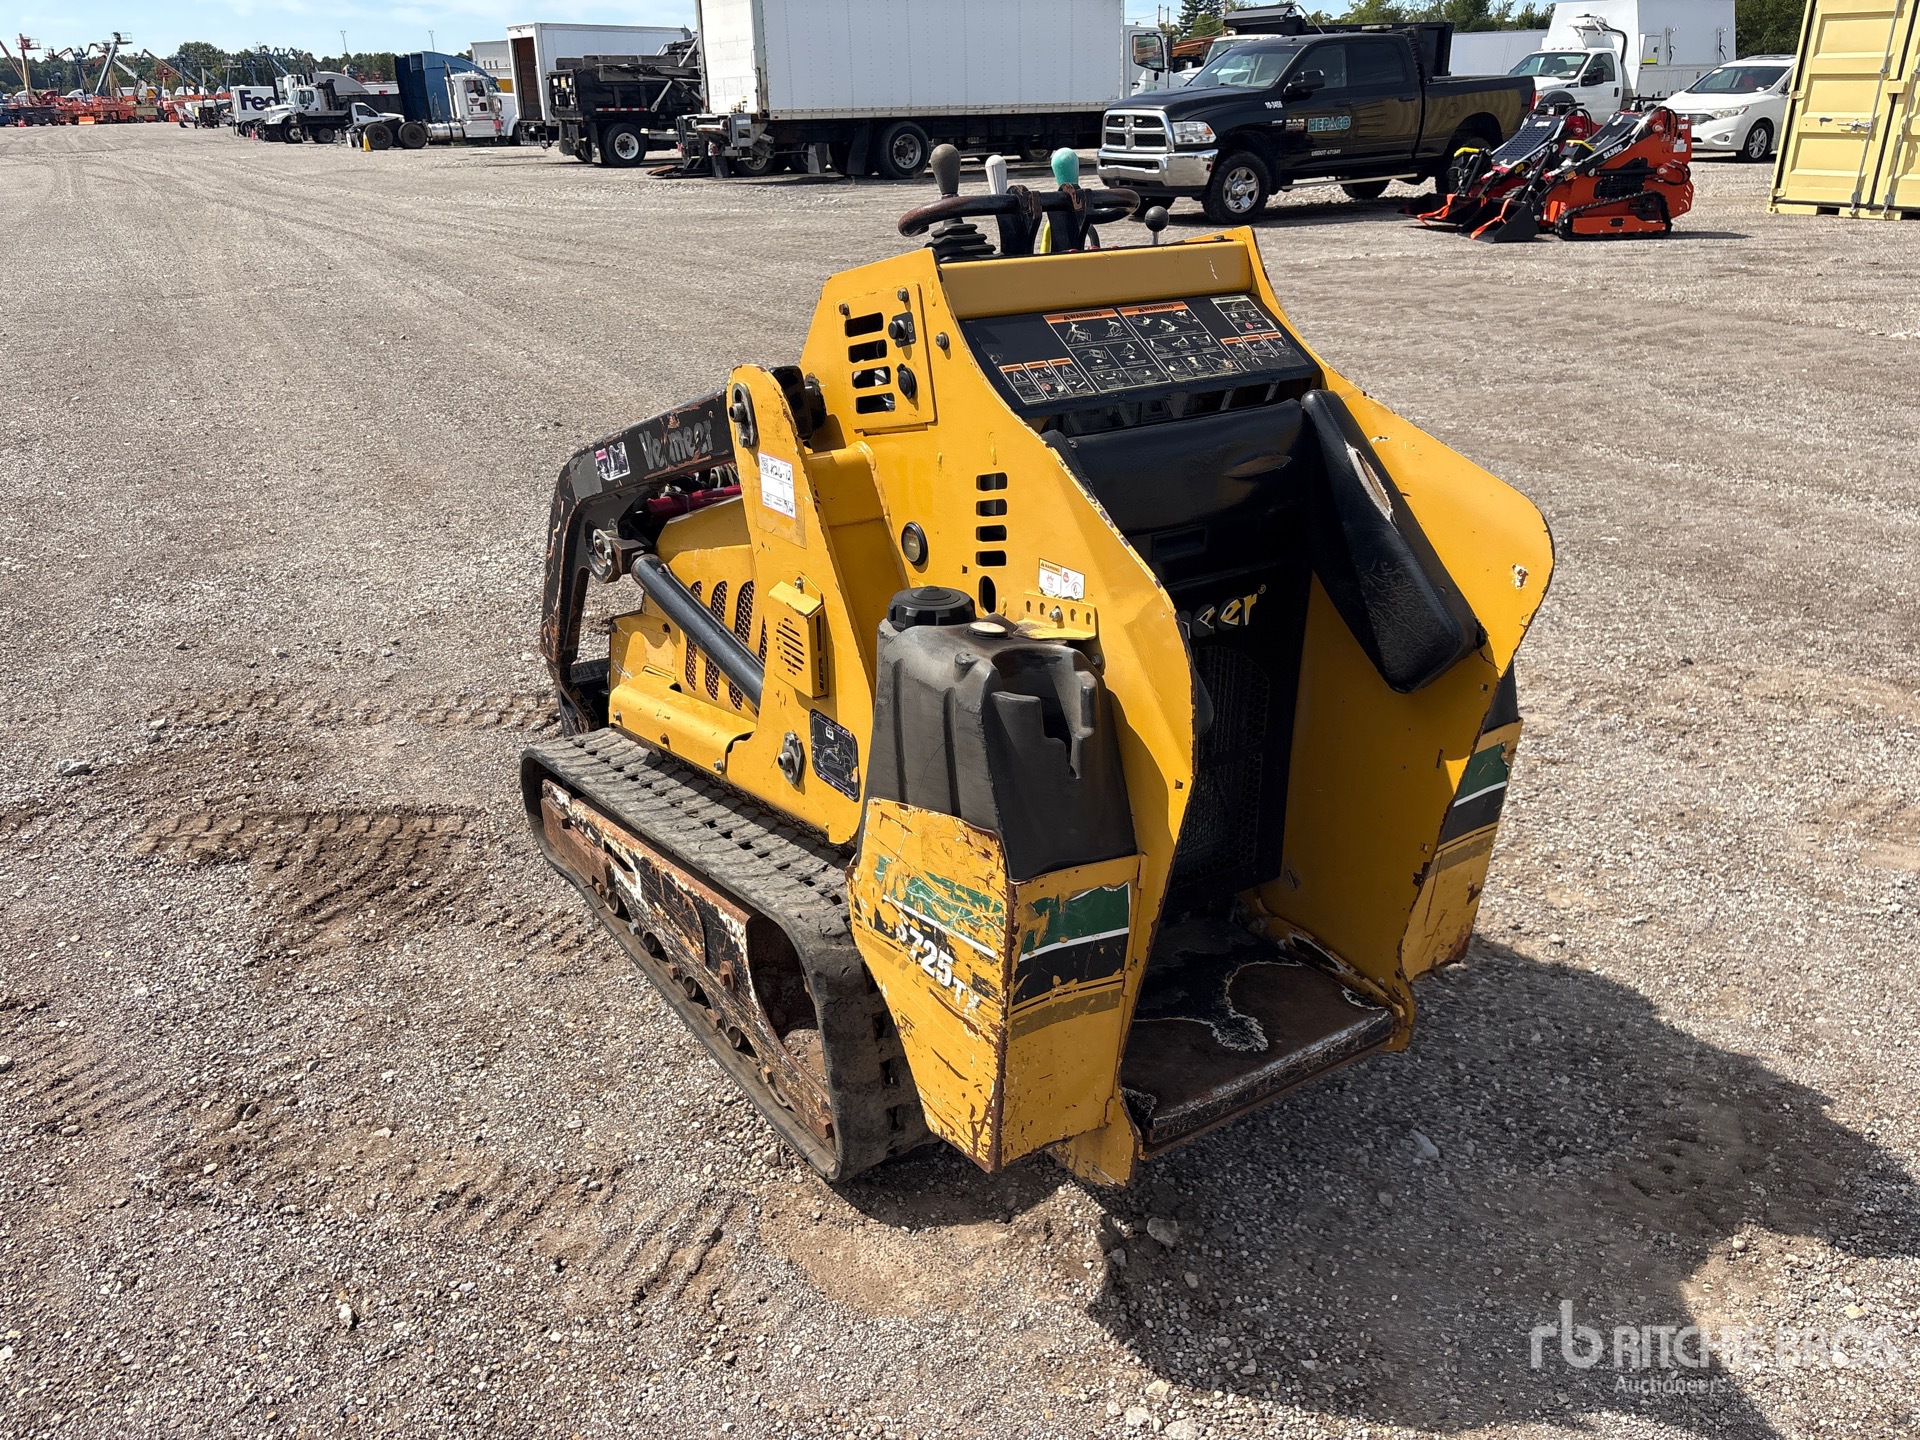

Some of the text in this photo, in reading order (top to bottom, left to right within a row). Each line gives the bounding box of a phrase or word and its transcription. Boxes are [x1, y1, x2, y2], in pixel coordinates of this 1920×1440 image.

[1307, 116, 1351, 132] HEPACO
[1602, 144, 1623, 160] SL36C
[1143, 303, 1175, 312] WARNING
[1068, 312, 1102, 320] WARNING
